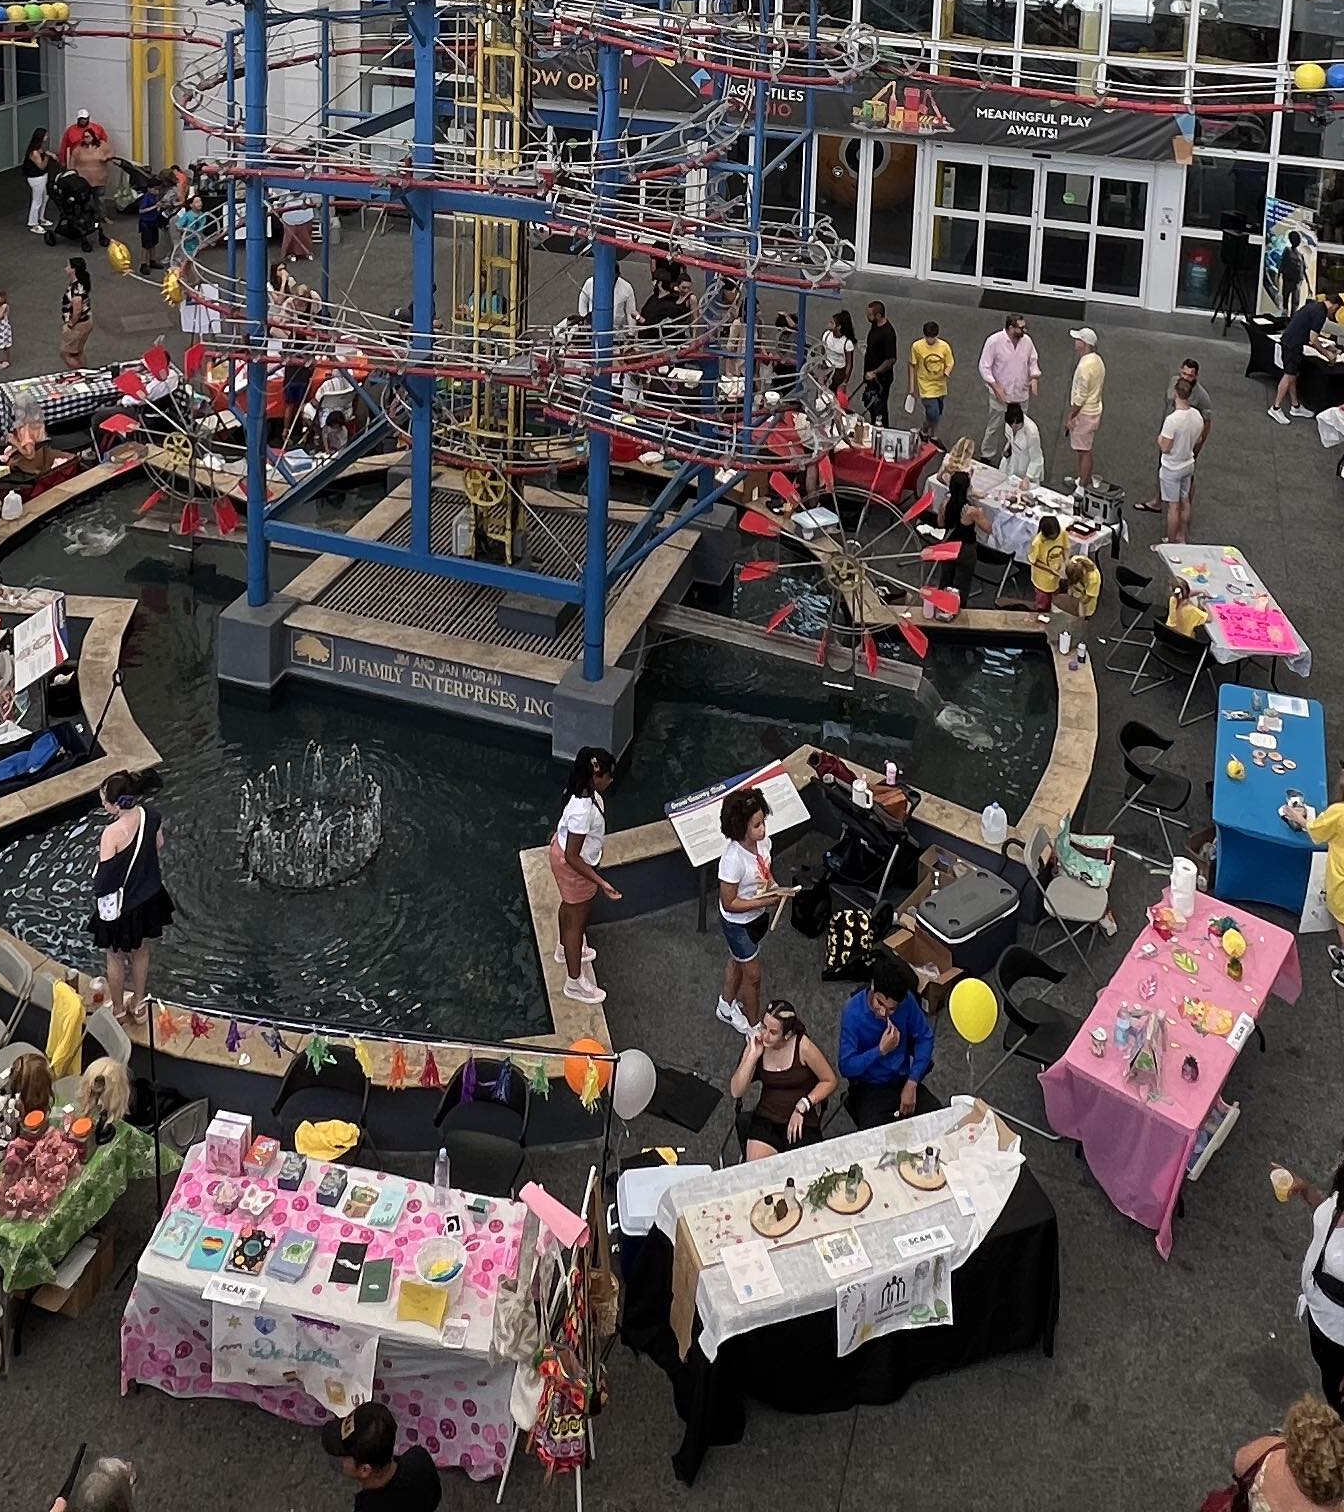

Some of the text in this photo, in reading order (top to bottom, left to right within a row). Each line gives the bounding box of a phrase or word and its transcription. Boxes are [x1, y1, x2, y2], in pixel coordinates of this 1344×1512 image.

[976, 108, 1092, 128] MEANINGFUL PLAY
[1007, 125, 1058, 139] AWAITS!
[413, 657, 436, 672] AND
[439, 662, 459, 678] JAN
[462, 668, 502, 687] MORAN
[338, 656, 356, 673] JM
[359, 659, 405, 684] FAMILY
[411, 671, 519, 713] ENTERPRISES,
[908, 1233, 932, 1245] SCAN
[221, 1283, 246, 1296] SCAN
